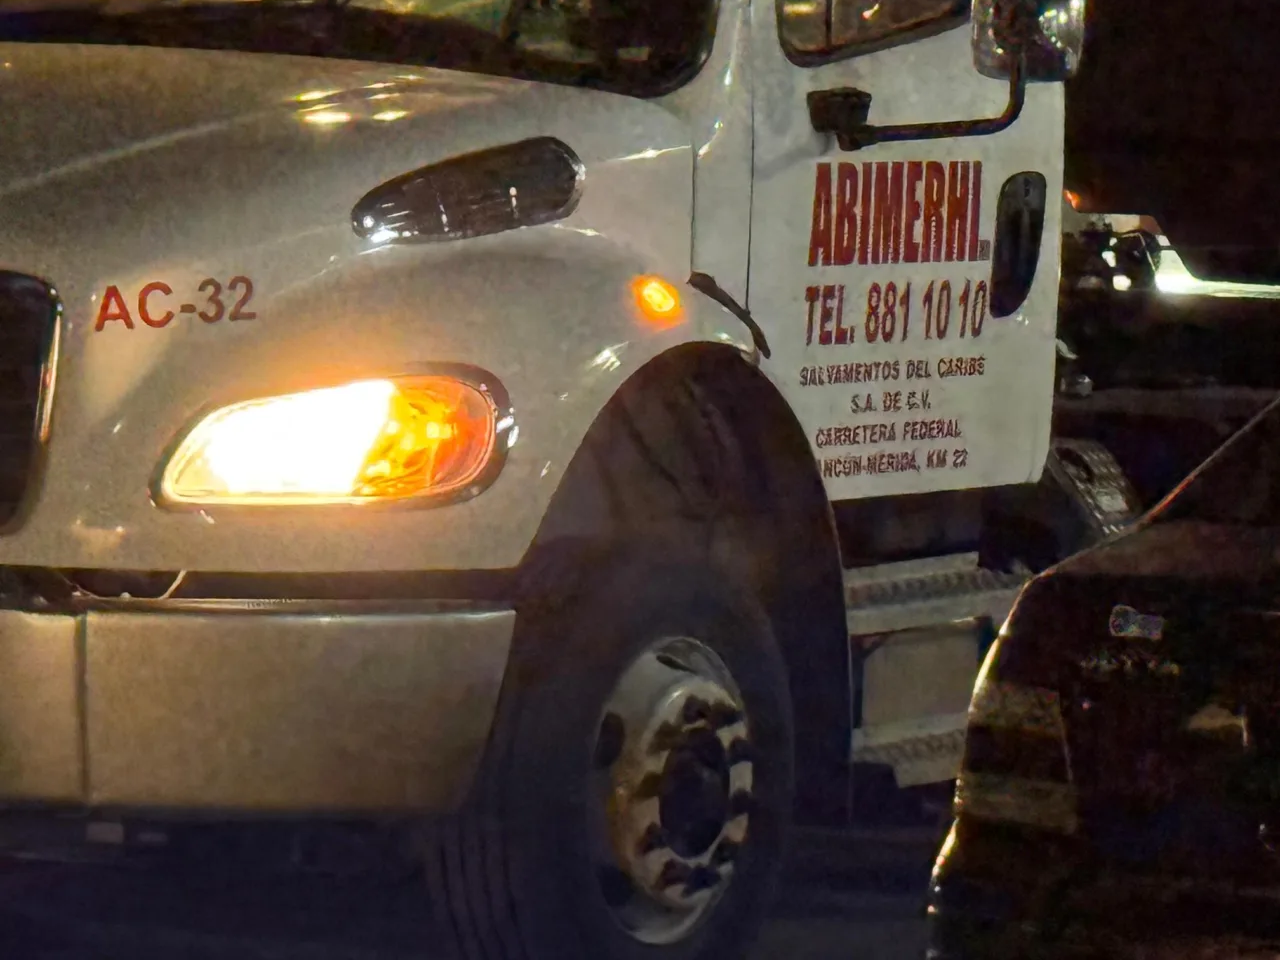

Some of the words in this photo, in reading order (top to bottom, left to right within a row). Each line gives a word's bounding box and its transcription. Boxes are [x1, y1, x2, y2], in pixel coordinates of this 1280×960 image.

[95, 275, 257, 332] AC-32
[805, 284, 855, 346] TEL.
[865, 281, 911, 343] 881
[923, 279, 951, 340] 10
[959, 276, 987, 339] 10
[799, 360, 900, 386] SALVAMENTOS
[906, 359, 931, 379] DEL
[937, 354, 985, 377] CARIBE
[882, 390, 902, 412] DE
[816, 423, 896, 448] CARRETERA
[903, 419, 961, 440] FEDERAL
